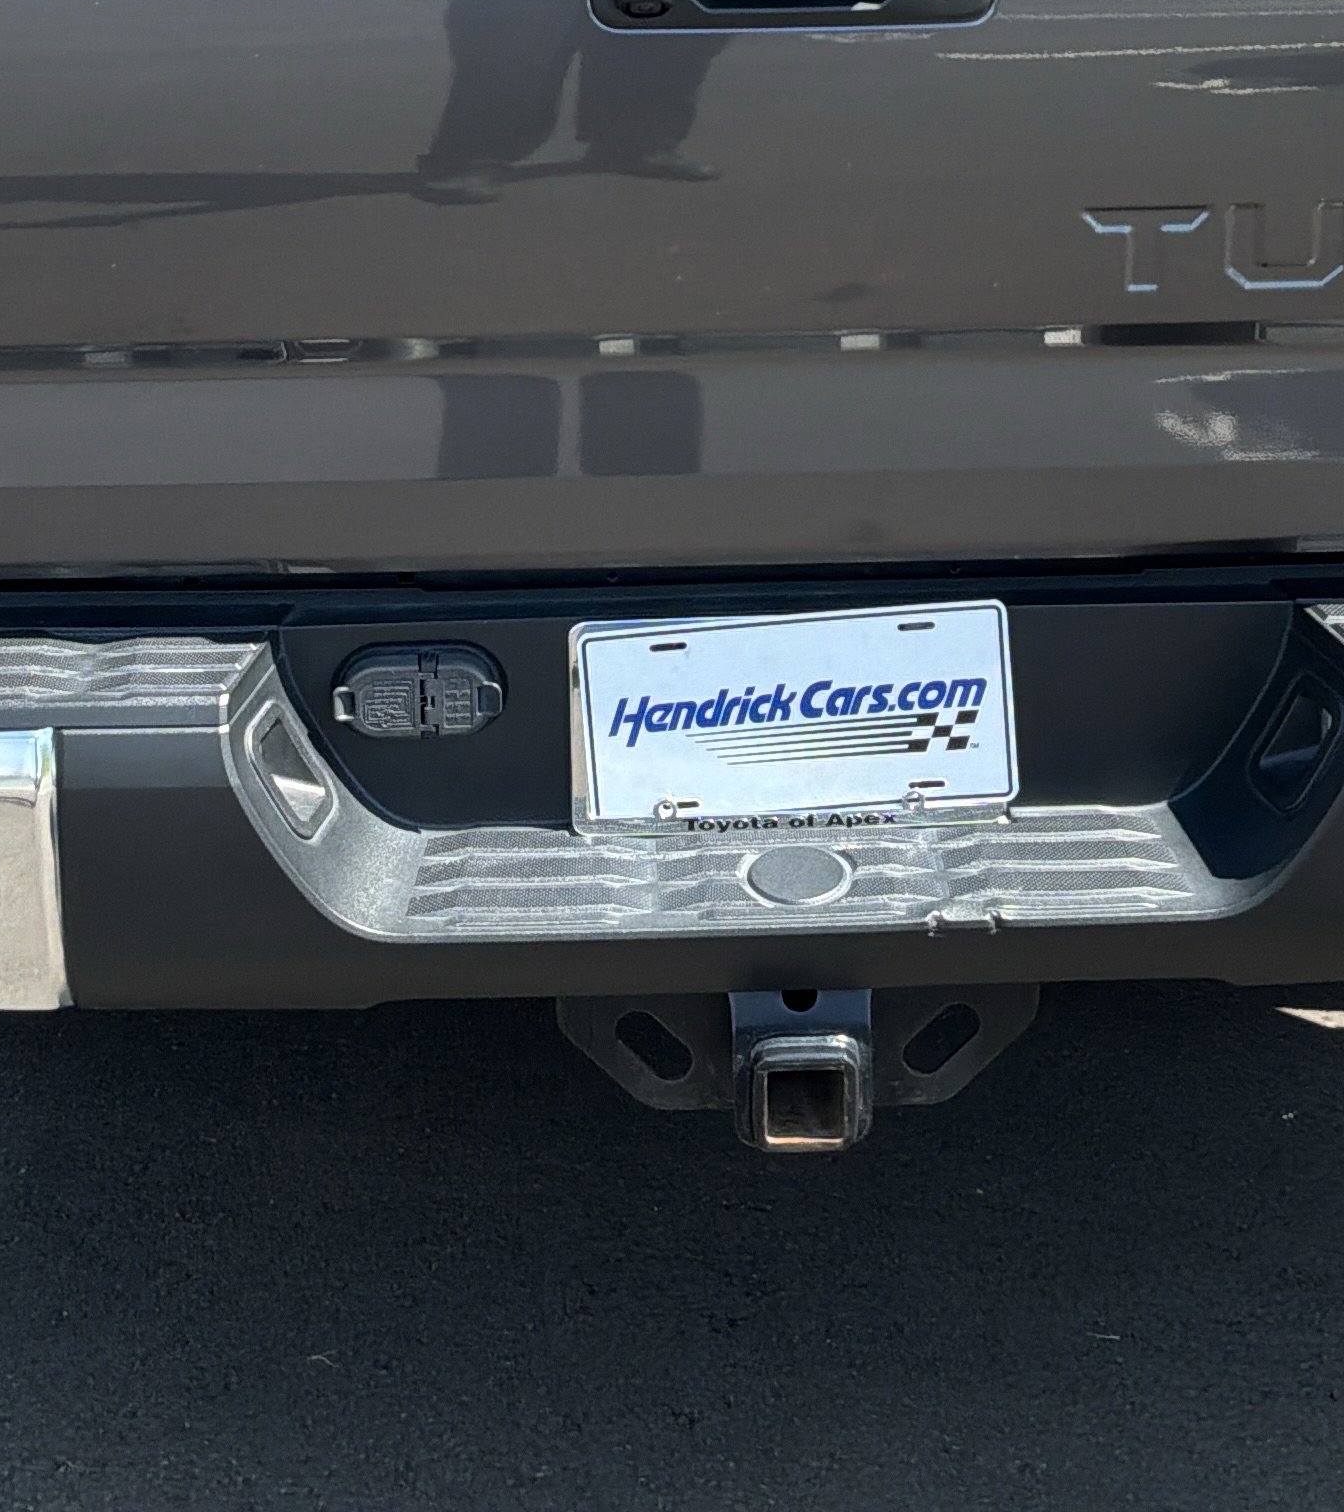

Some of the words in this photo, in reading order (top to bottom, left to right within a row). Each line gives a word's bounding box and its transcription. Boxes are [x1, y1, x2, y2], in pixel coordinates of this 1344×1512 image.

[684, 816, 778, 833] Toyota
[789, 814, 814, 828] of
[826, 812, 897, 828] Apex
